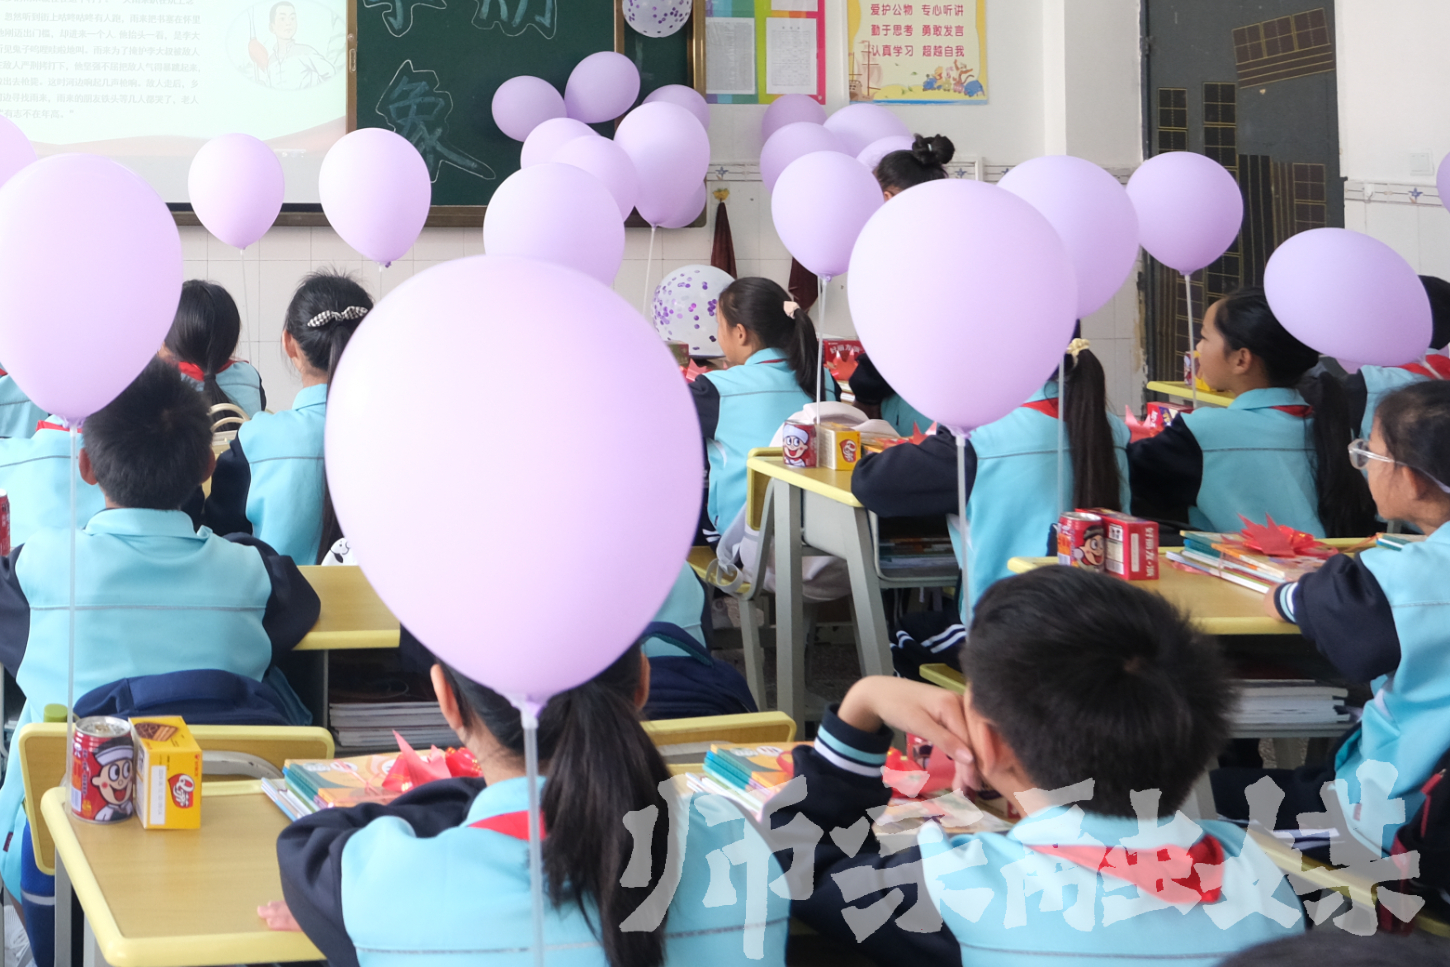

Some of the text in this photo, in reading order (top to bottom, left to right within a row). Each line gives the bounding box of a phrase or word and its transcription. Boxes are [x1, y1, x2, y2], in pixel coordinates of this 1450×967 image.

[870, 4, 963, 17] 爱护公物 专心听讲
[871, 24, 964, 37] 勤于思考 勇敢发言
[871, 45, 964, 58] 认真学习 超越自我
